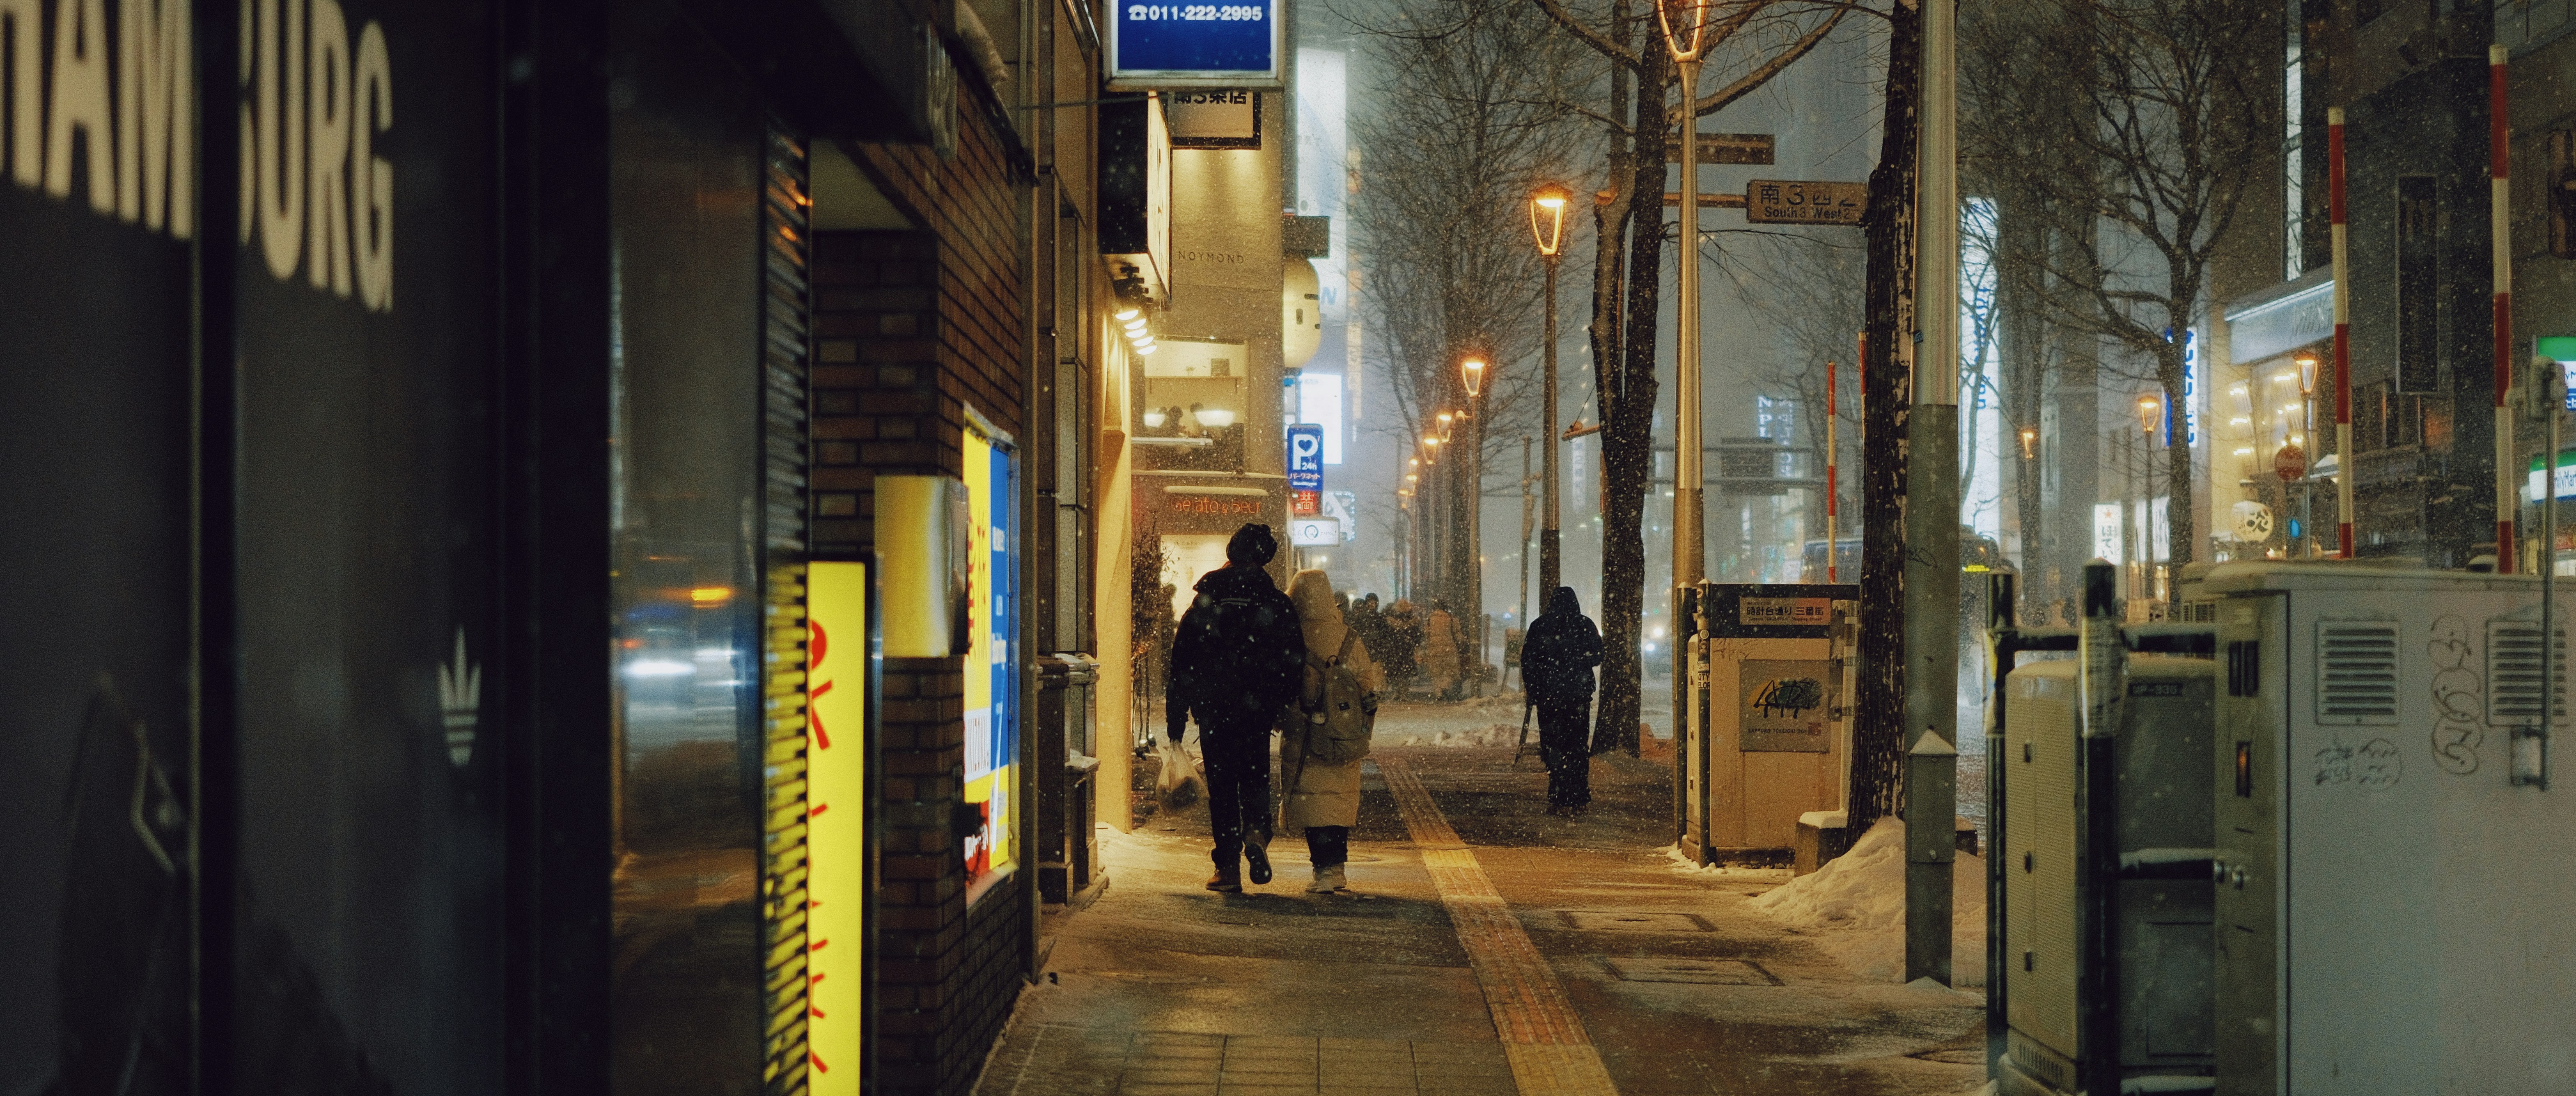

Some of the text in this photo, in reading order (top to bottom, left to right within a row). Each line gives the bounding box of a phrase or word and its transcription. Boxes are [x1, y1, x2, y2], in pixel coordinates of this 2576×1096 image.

[1178, 251, 1244, 264] NOYMOND
[1747, 606, 1824, 616] 時計台通り 三番街
